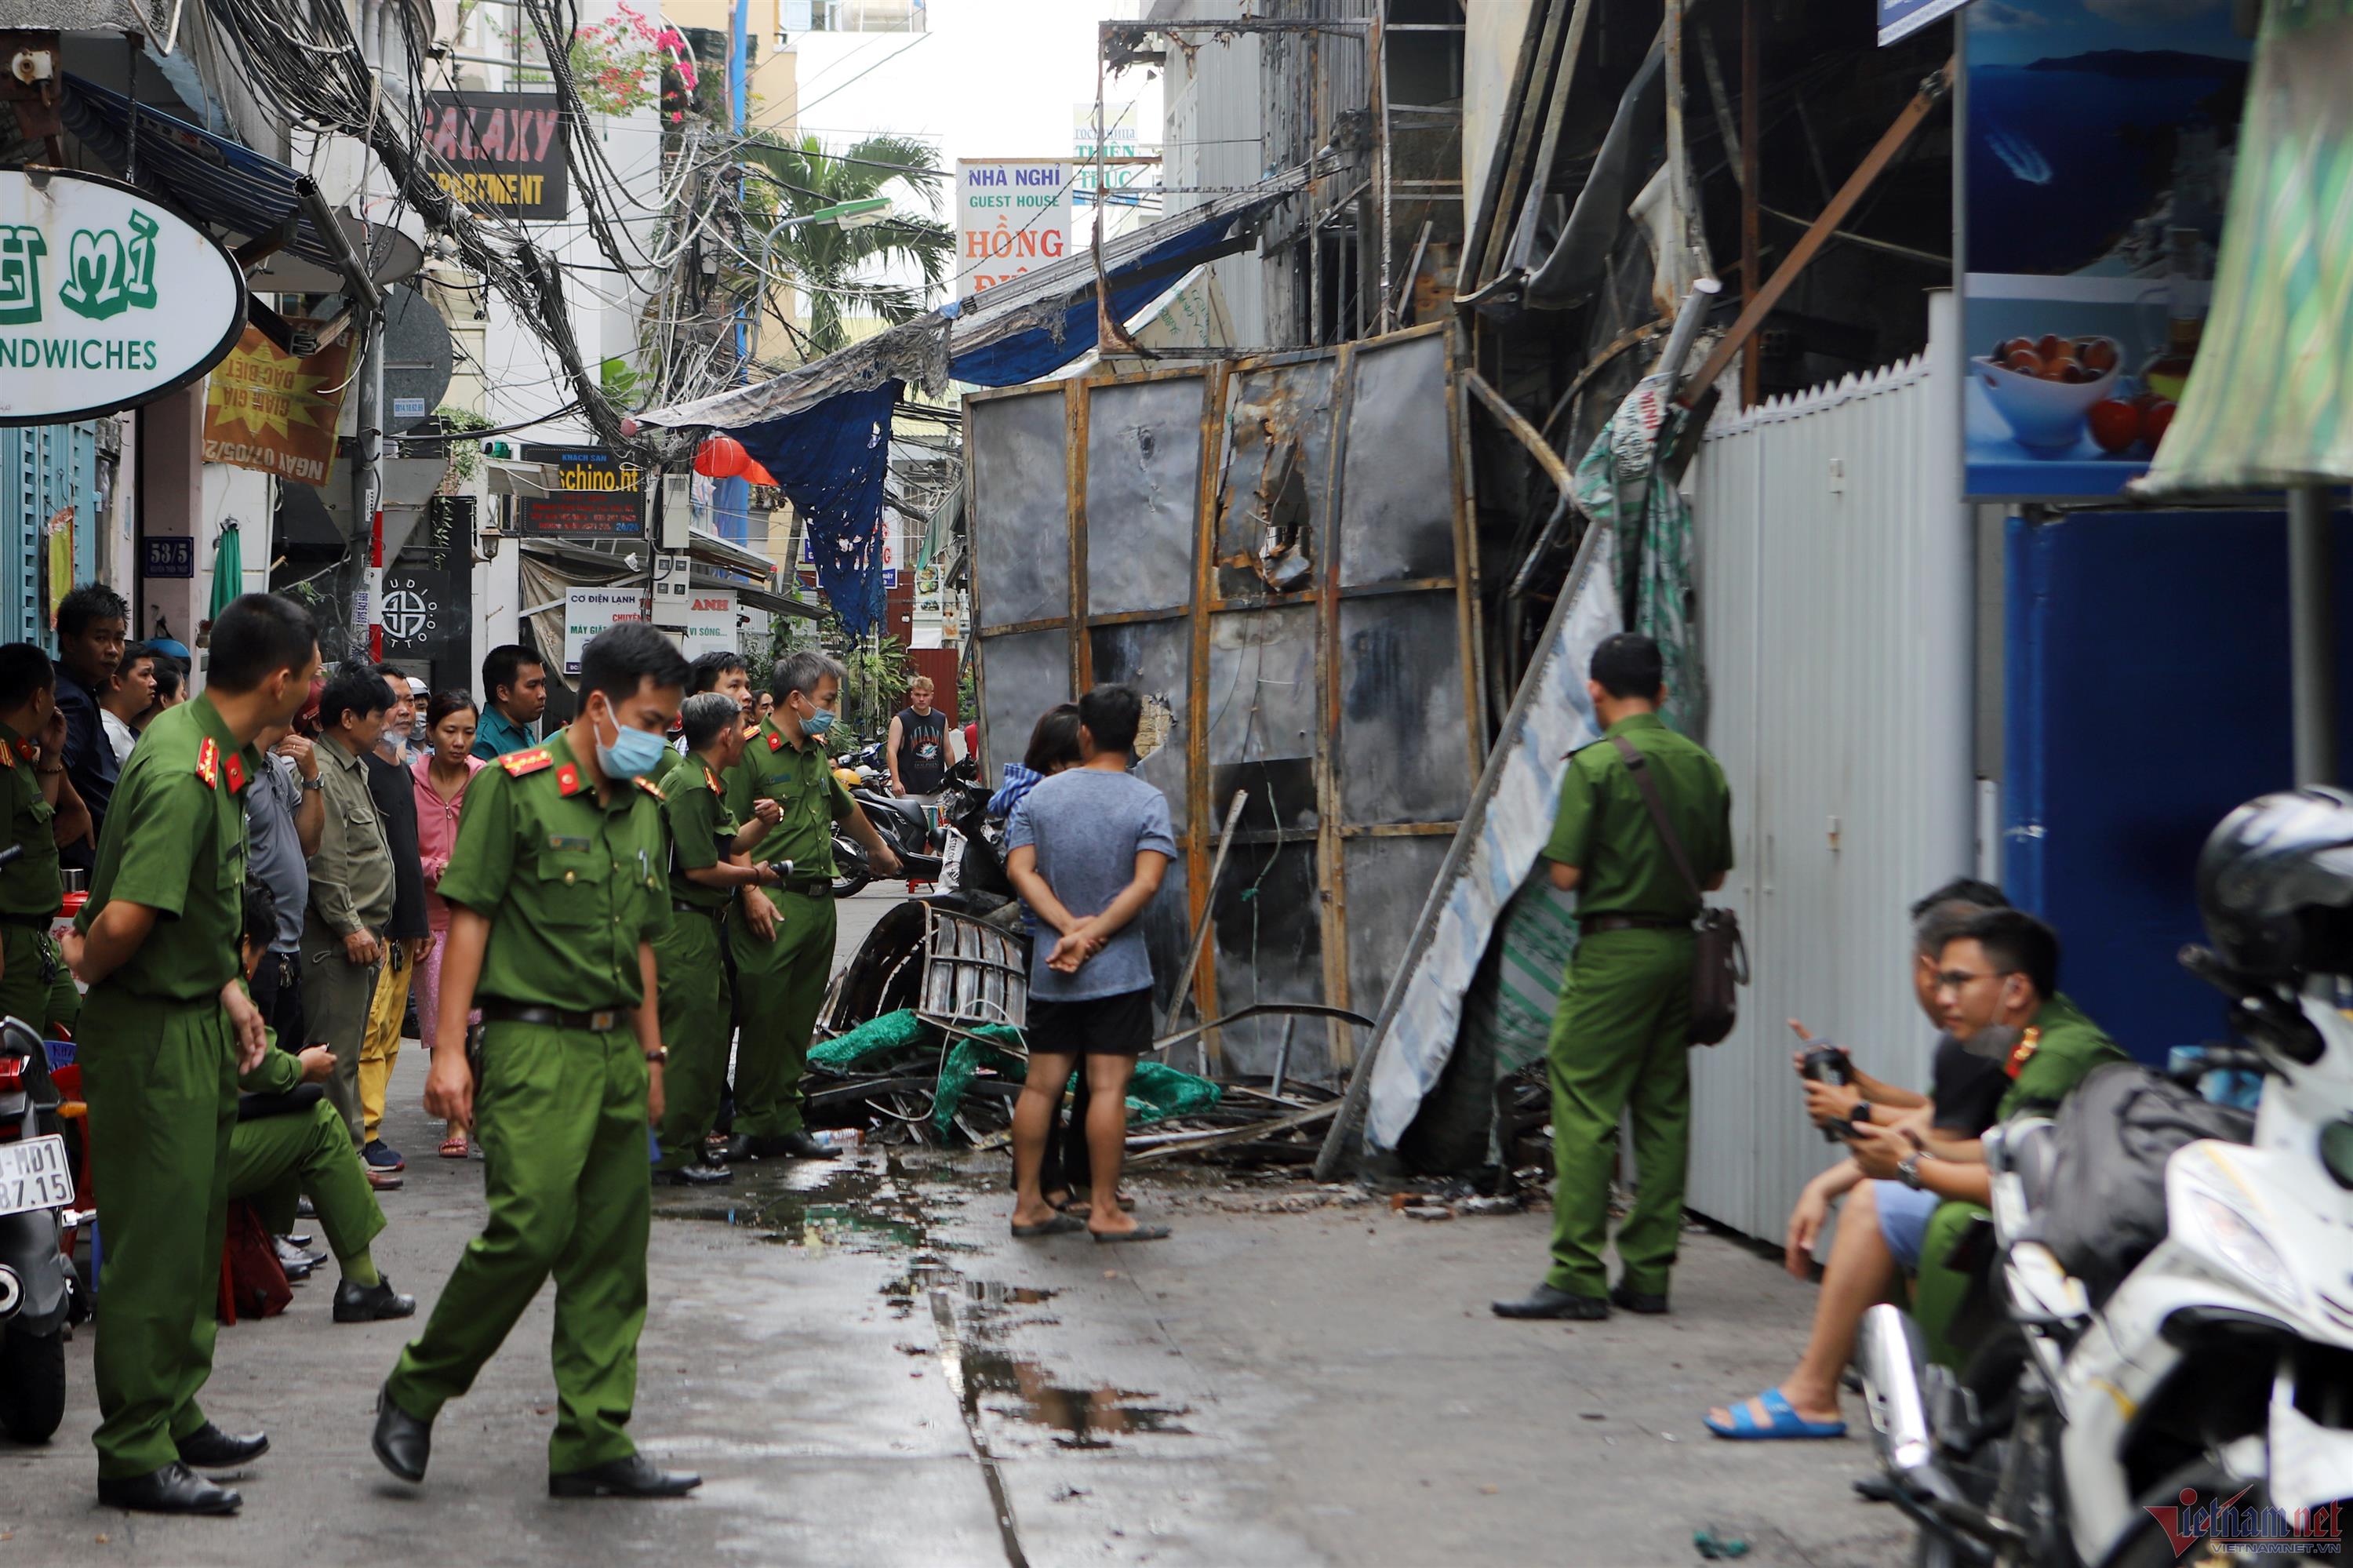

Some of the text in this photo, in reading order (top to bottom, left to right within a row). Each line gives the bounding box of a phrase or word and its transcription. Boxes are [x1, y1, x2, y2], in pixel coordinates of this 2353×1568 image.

[969, 163, 1060, 186] NHÀ NGHỈ
[969, 195, 1012, 208] GUEST
[1016, 195, 1060, 208] HOUSE
[966, 214, 1064, 258] HỒNG
[151, 543, 187, 564] 53/5
[571, 595, 586, 603] CƠ
[588, 594, 610, 605] ĐIỆN
[612, 596, 635, 606] LẠNH
[691, 598, 729, 611] ANH
[570, 624, 587, 635] MÁY
[689, 628, 697, 636] VI
[911, 726, 943, 753] MIAMI
[0, 1144, 56, 1177] -MD1
